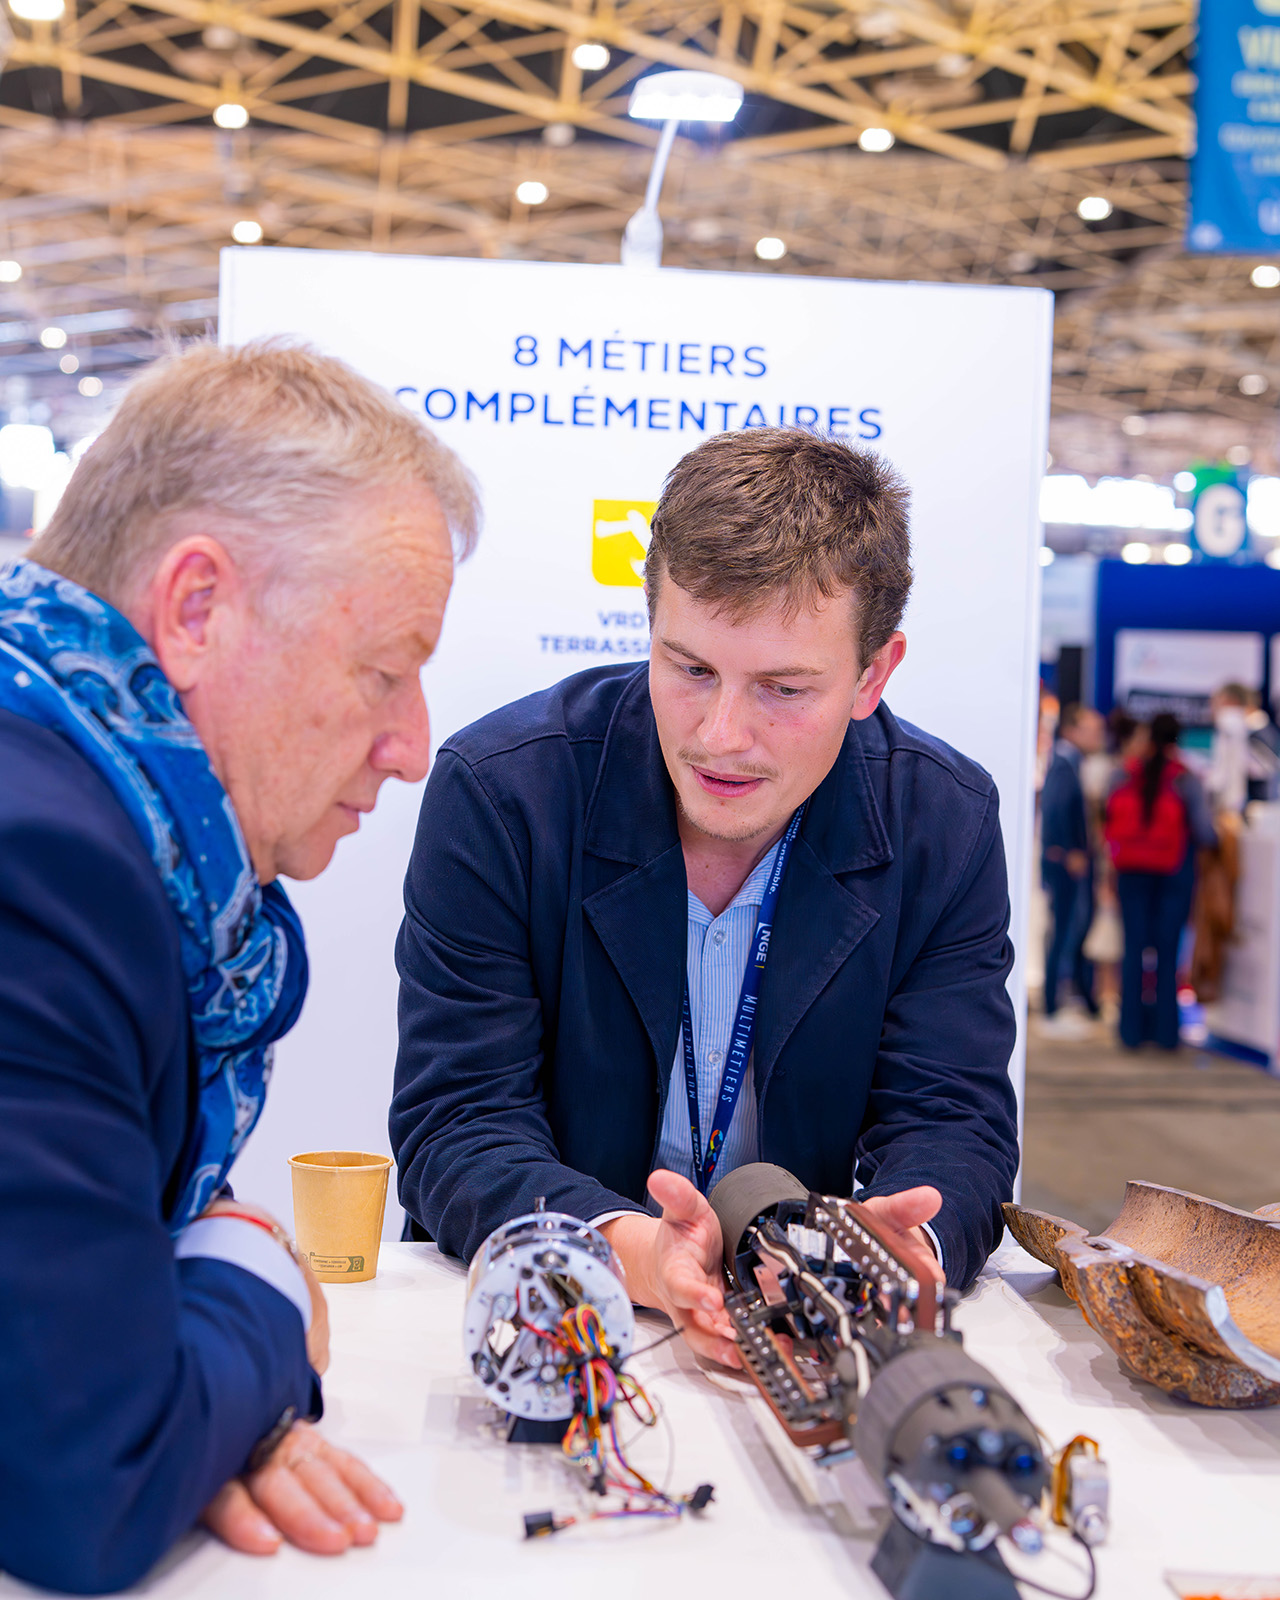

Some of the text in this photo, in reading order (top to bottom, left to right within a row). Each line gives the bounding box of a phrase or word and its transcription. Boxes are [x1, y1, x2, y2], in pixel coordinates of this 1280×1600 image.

[513, 330, 767, 379] 8 MÉTIERS
[1195, 483, 1246, 557] G
[539, 636, 651, 655] TERRASS
[769, 842, 787, 895] ensemble.
[721, 994, 758, 1103] MULTIMÉTIERS
